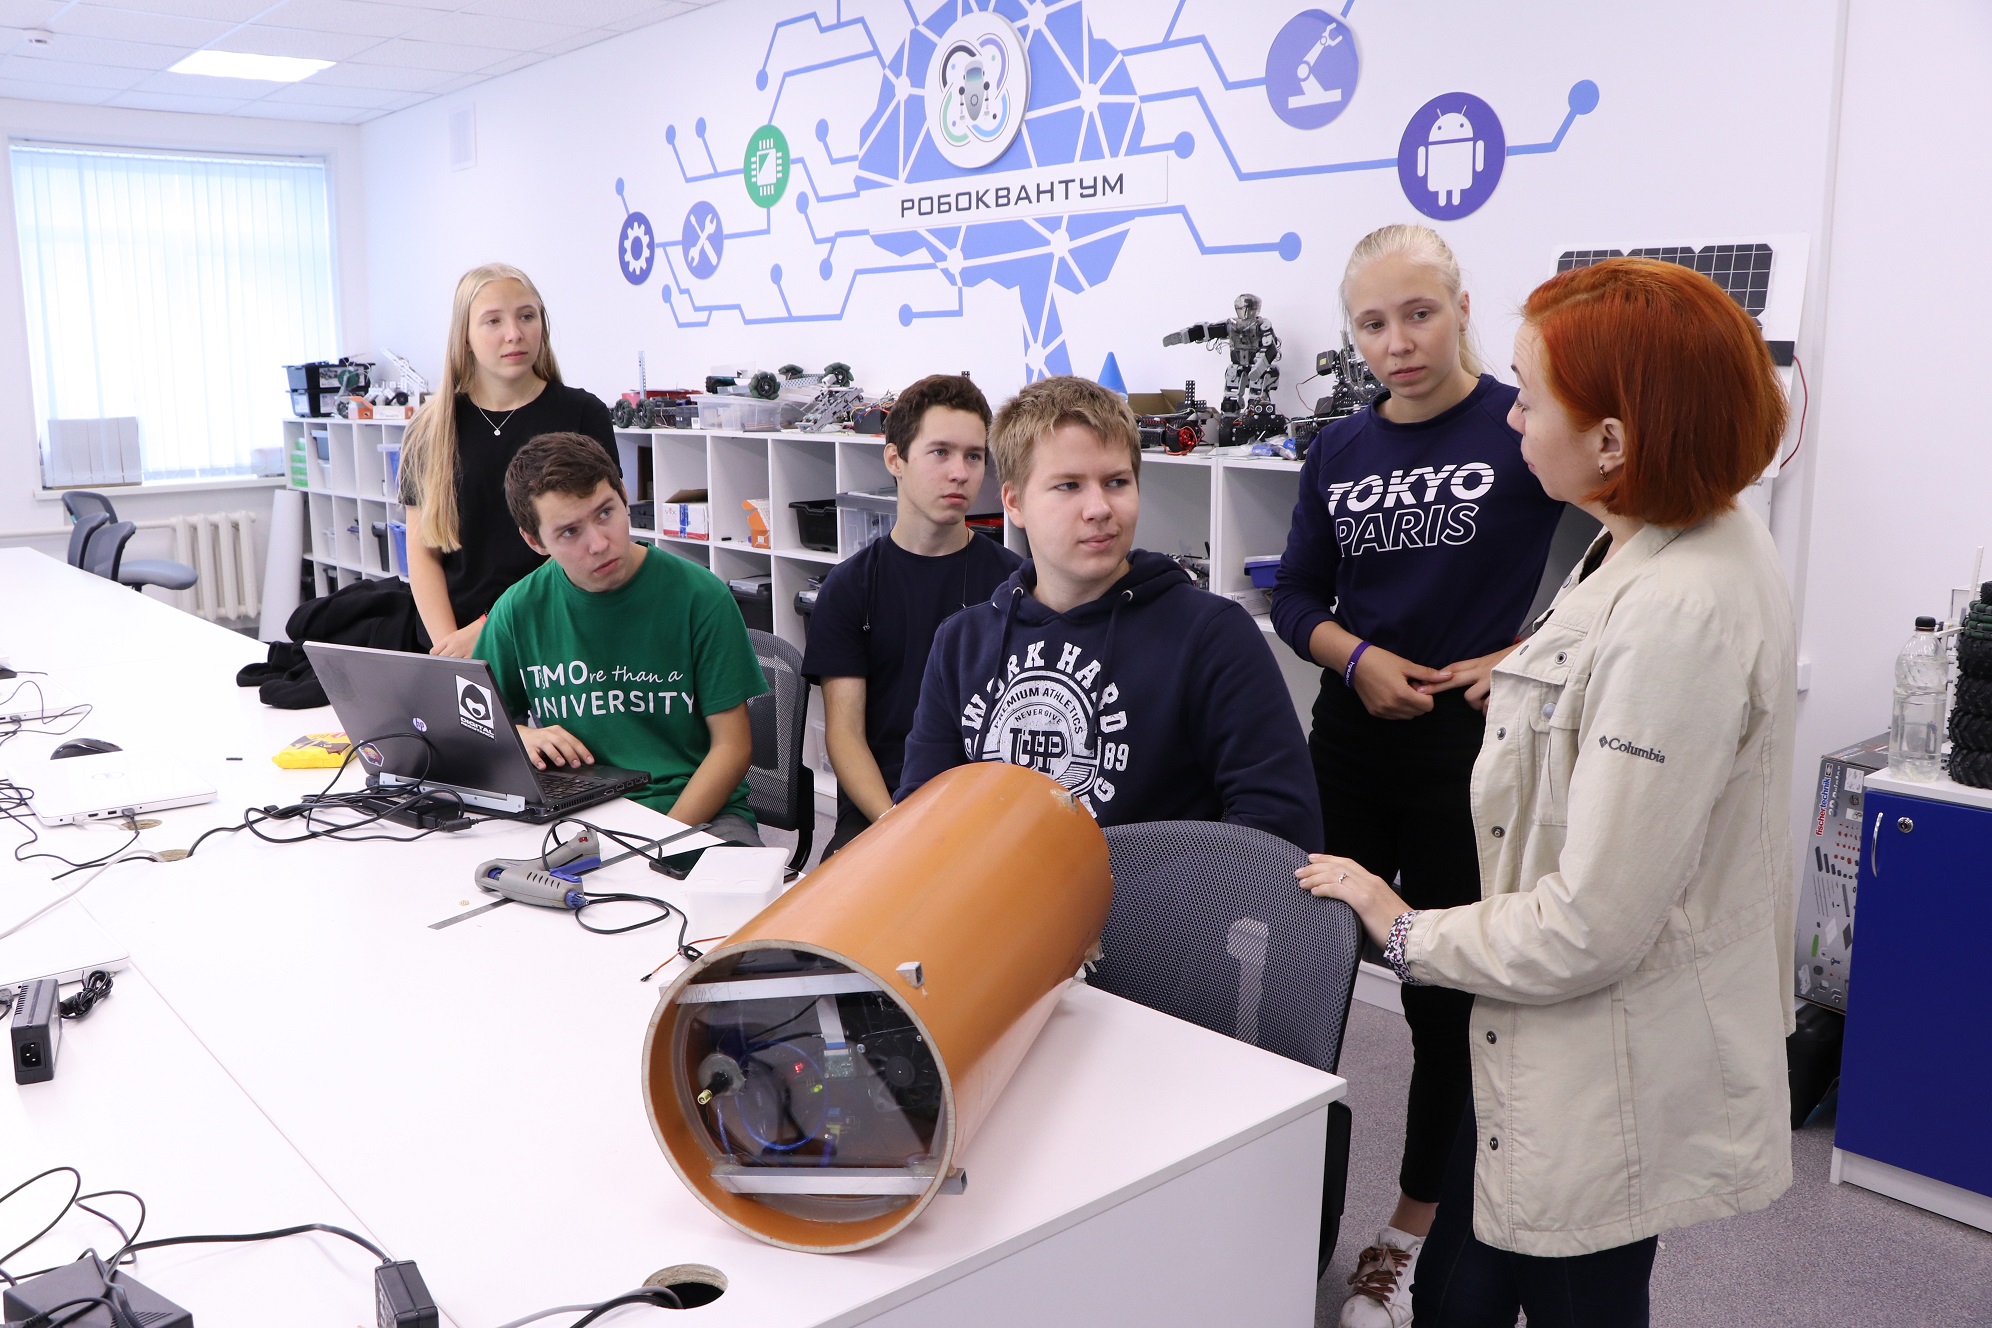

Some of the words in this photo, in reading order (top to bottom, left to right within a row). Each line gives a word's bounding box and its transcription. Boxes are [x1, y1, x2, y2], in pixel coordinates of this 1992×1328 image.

[900, 172, 1125, 218] РОБОКВАНТУМ
[1327, 461, 1495, 516] TOKYO
[1335, 502, 1480, 558] PARIS
[611, 665, 663, 683] than
[668, 671, 683, 682] a
[1056, 641, 1128, 734] HARD
[460, 717, 495, 736] DIGITAL
[993, 687, 1040, 729] PREMIUM
[1042, 687, 1083, 735] ATHLETICS
[1103, 742, 1130, 772] 89
[1608, 737, 1666, 764] Columbia
[1815, 777, 1831, 836] fischertechnik
